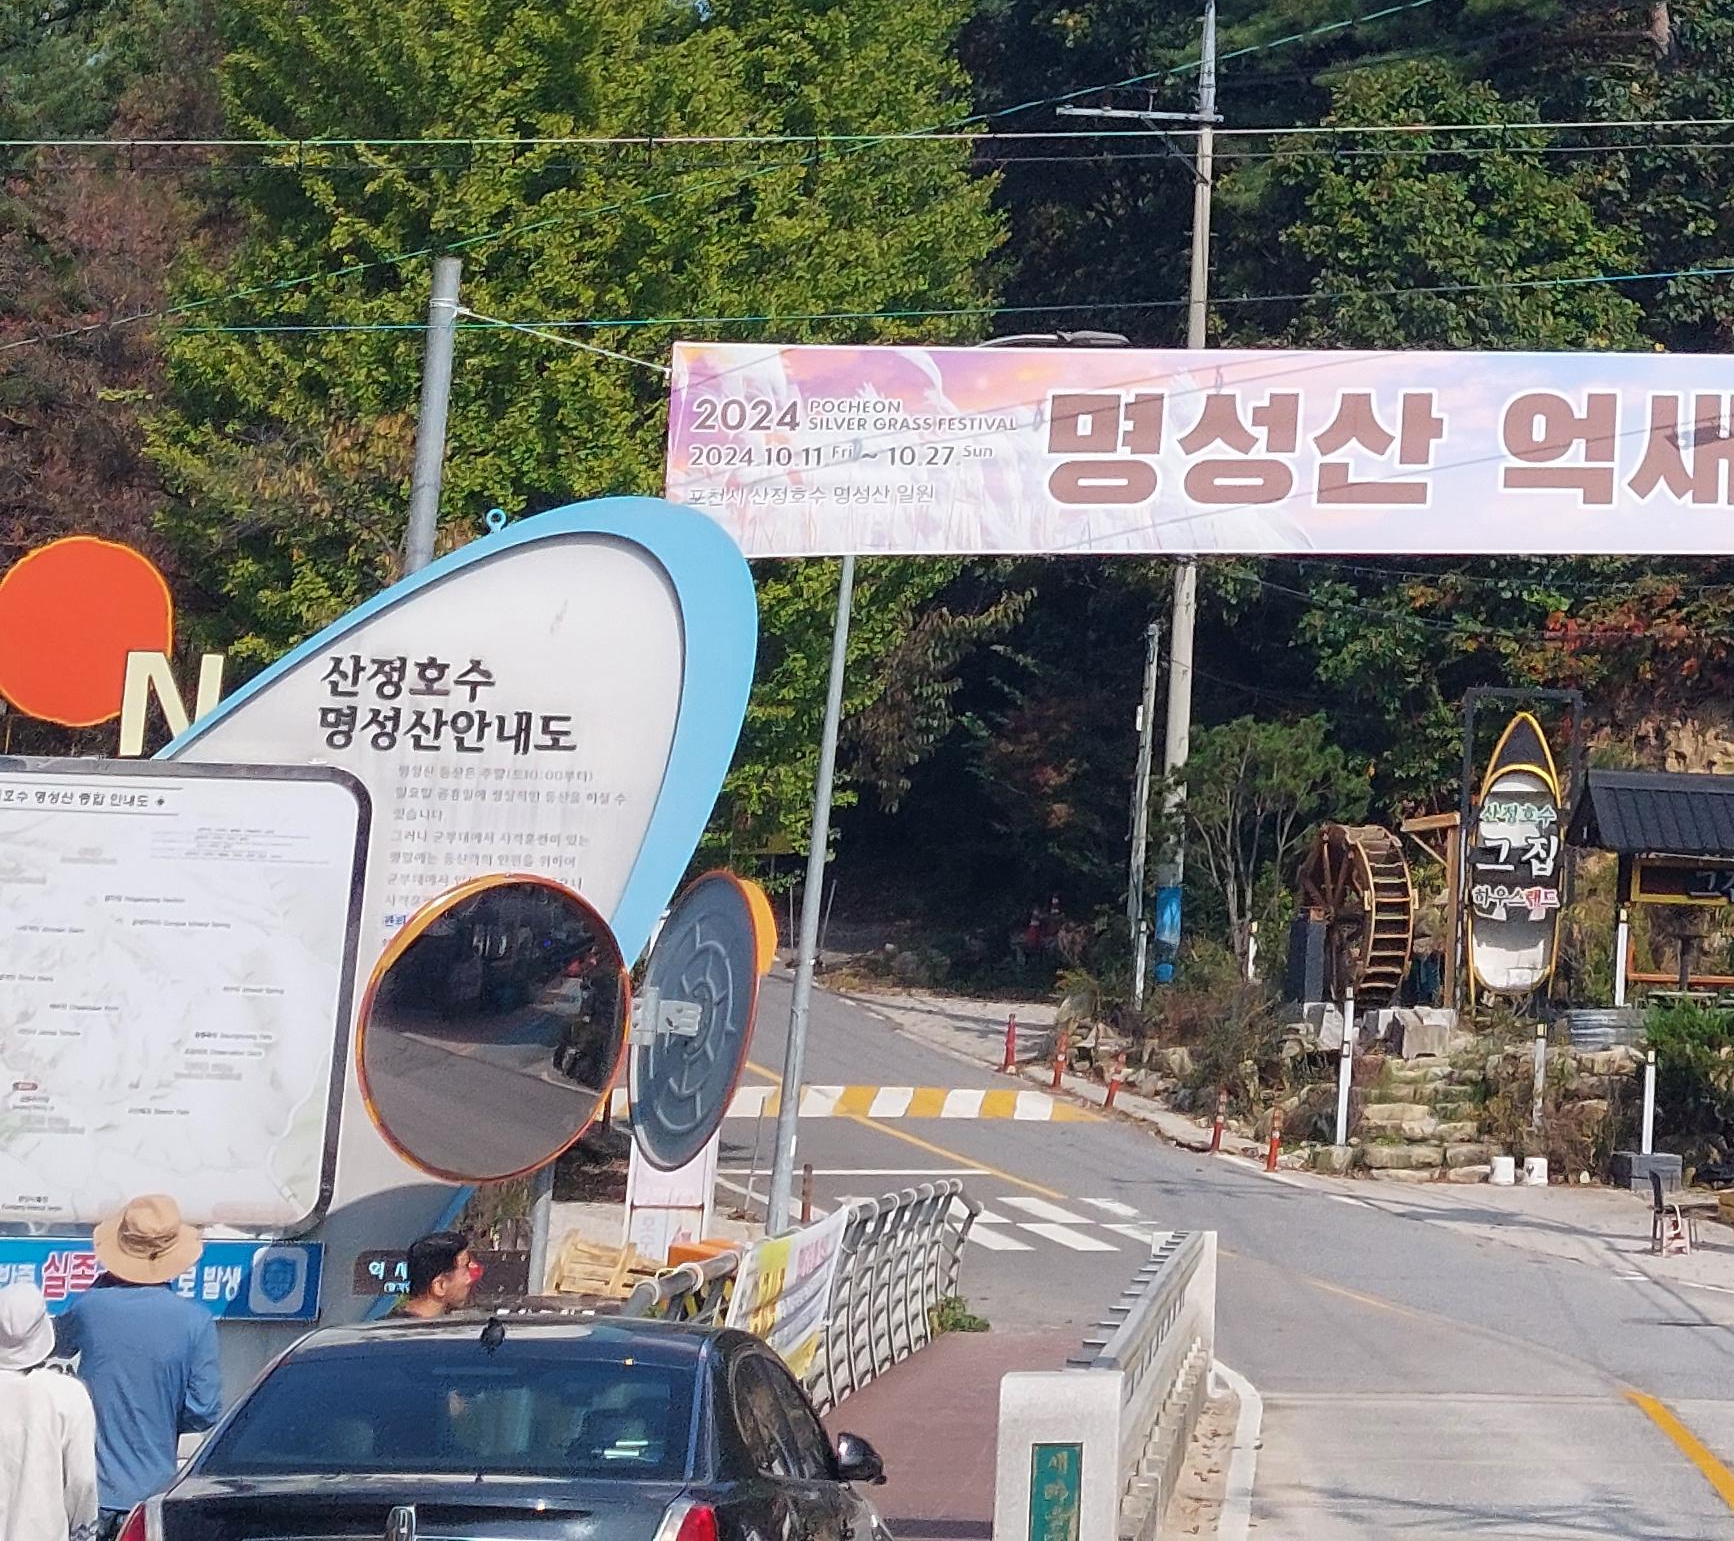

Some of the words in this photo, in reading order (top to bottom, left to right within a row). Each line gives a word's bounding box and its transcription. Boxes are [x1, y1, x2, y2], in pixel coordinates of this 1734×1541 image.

[693, 398, 800, 432] 2024
[809, 400, 901, 414] POCHEON
[808, 417, 866, 431] SILVER
[873, 417, 932, 431] GRASS
[937, 417, 1017, 431] FESTIVAL
[963, 446, 993, 459] Sun
[1048, 393, 1443, 504] 명성산
[687, 485, 745, 507] 포천시
[750, 485, 829, 505] 산정호수
[833, 485, 890, 504] 명성산
[896, 484, 934, 503] 일원
[320, 654, 496, 703] 산정호수
[318, 705, 577, 755] 명성산안내도
[614, 792, 627, 806] 수
[1481, 801, 1557, 826] 산정호수
[202, 1265, 241, 1301] 발생
